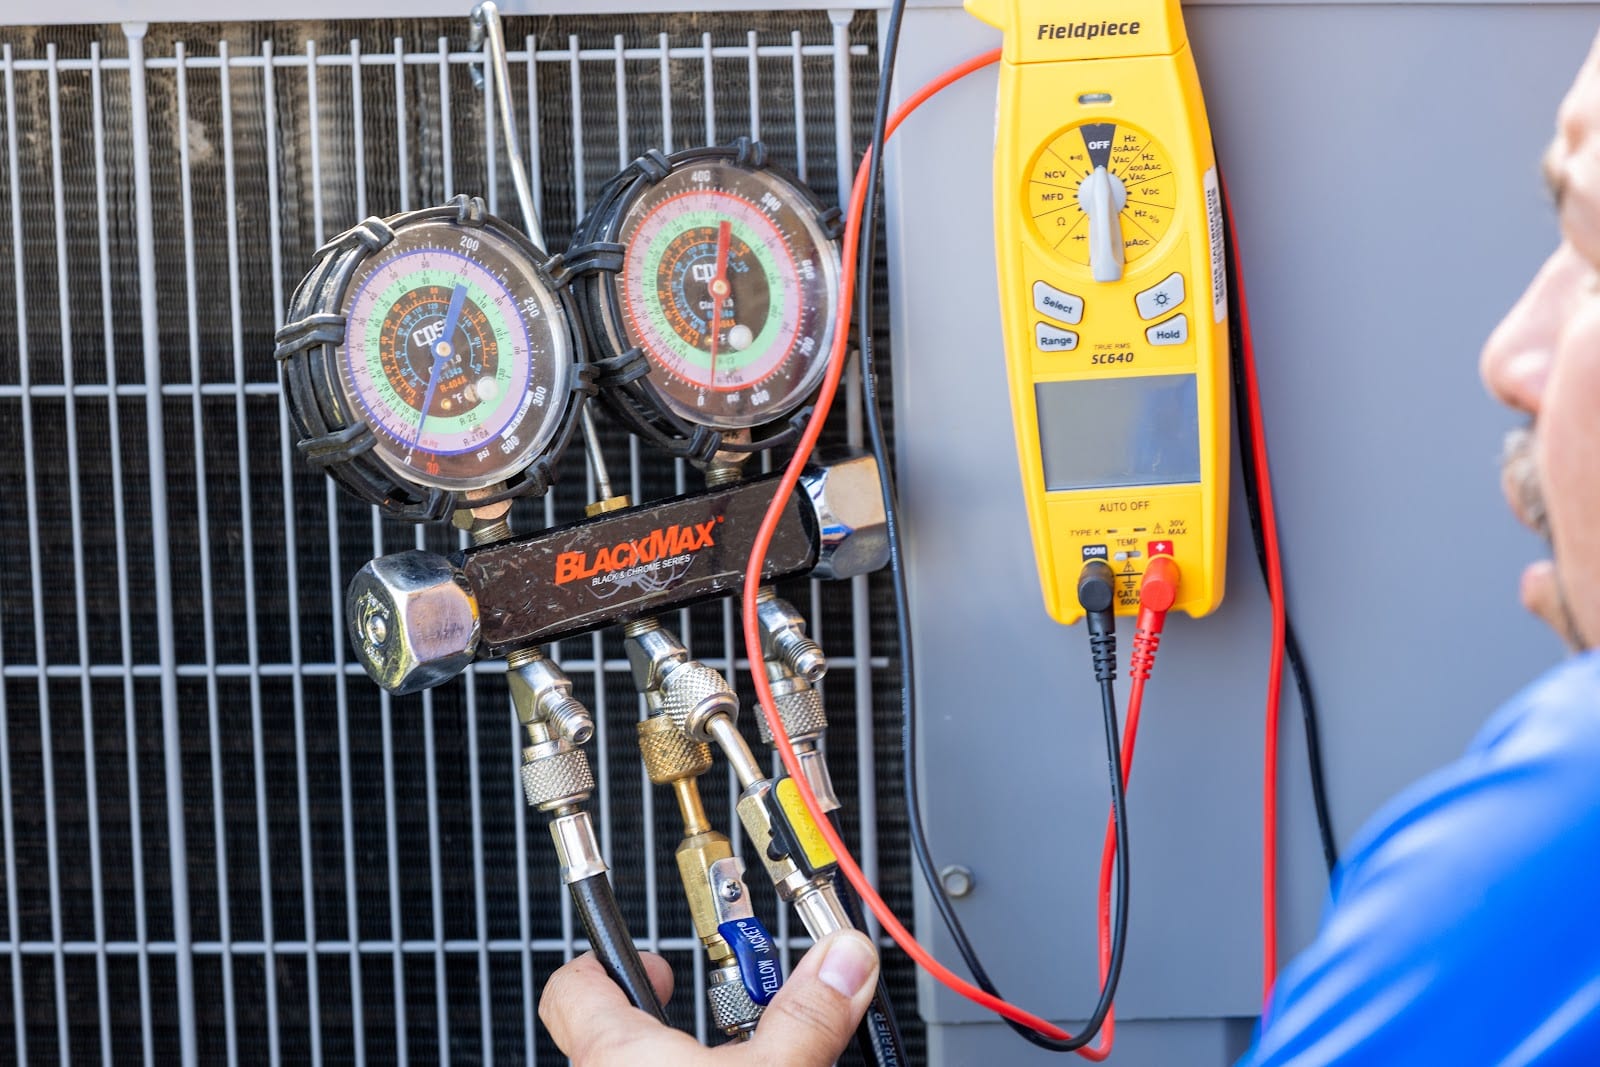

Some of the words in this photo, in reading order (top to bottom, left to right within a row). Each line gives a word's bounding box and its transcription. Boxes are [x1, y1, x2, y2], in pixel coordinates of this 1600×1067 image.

[1037, 21, 1140, 40] Fieldpiece
[1088, 140, 1110, 150] OFF
[1142, 153, 1154, 161] Hz
[692, 169, 711, 182] 400
[1044, 170, 1066, 178] NCV
[1041, 193, 1064, 201] MFD
[460, 235, 479, 251] 200
[523, 297, 540, 318] 250
[1042, 296, 1073, 314] Select
[1040, 336, 1072, 346] Range
[1156, 330, 1180, 339] Hold
[799, 336, 815, 357] 700
[1091, 352, 1134, 365] SC640
[532, 385, 547, 407] 300
[501, 435, 520, 454] 500
[476, 447, 490, 462] psi
[1099, 502, 1127, 512] AUTO
[1130, 501, 1150, 511] OFF
[1116, 538, 1138, 546] TEMP
[555, 519, 716, 586] BLACKMAX
[1083, 546, 1106, 555] COM
[592, 572, 618, 587] BLACK
[619, 571, 625, 579] &
[626, 561, 662, 577] CHROME
[662, 554, 691, 569] SERIES
[1117, 590, 1133, 598] CAT
[757, 959, 779, 997] YELLOW
